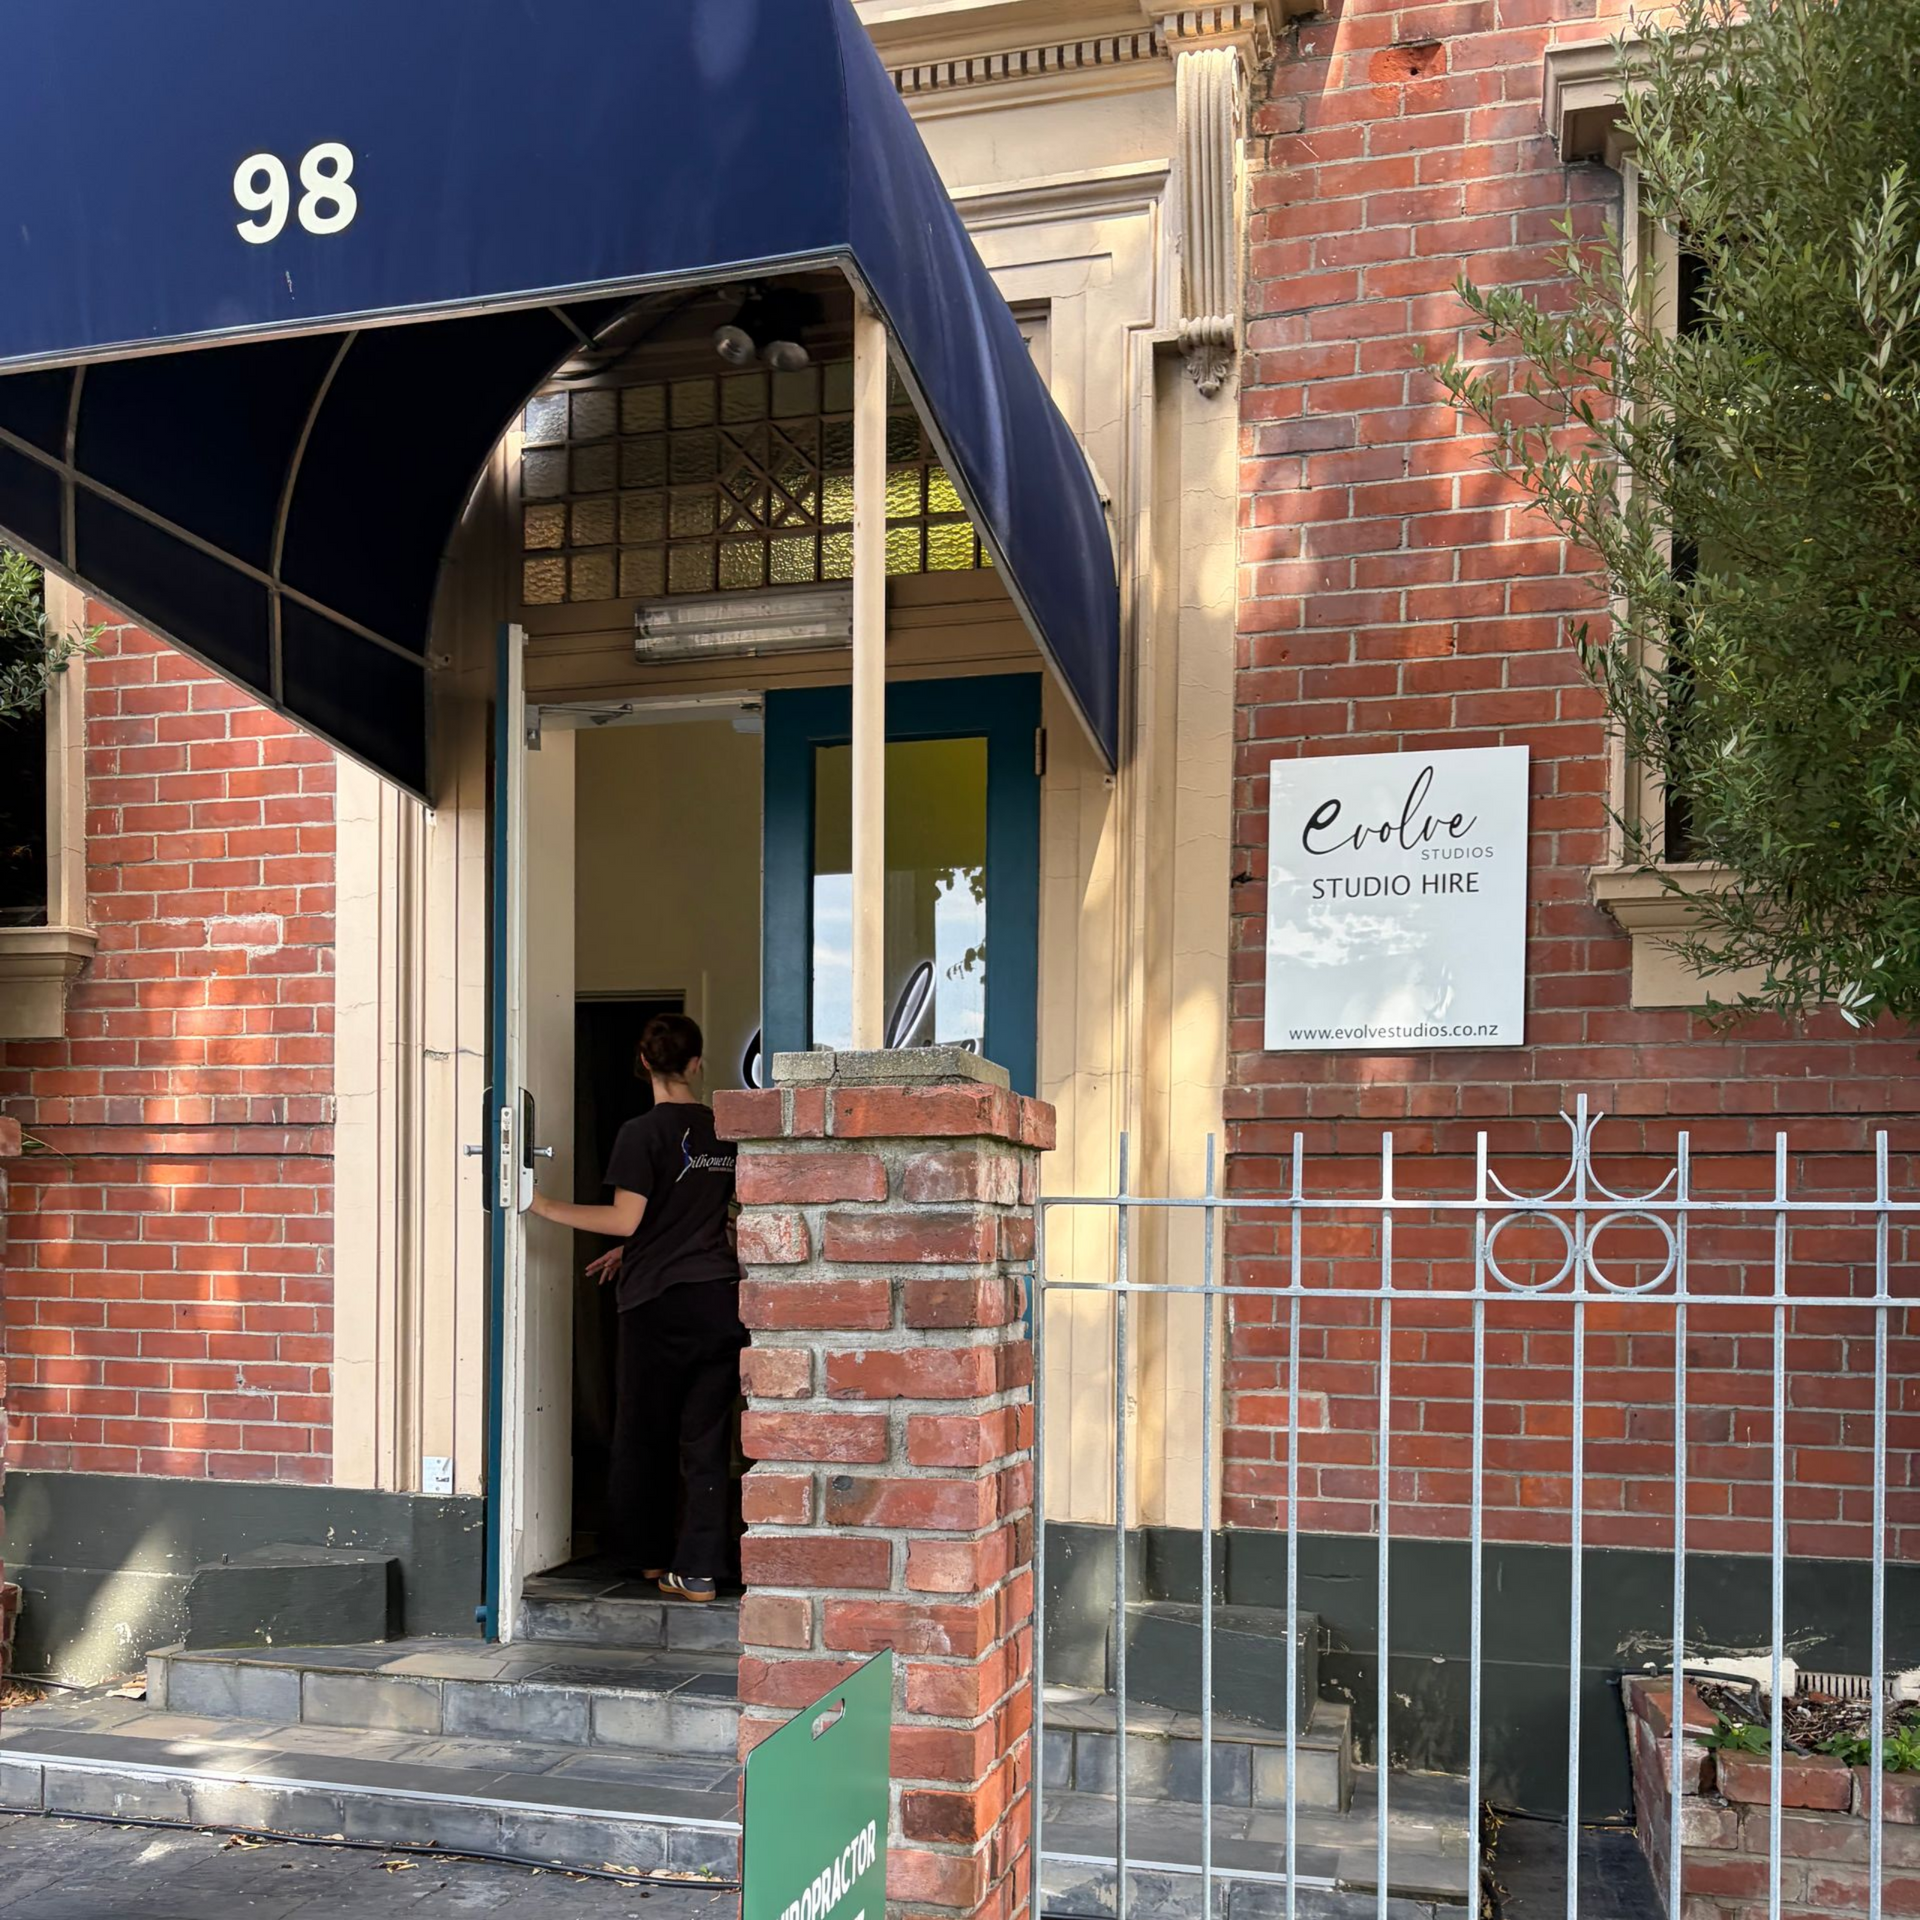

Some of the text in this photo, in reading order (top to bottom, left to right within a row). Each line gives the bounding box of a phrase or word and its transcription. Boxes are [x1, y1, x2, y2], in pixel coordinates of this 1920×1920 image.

[233, 142, 358, 244] 98
[1421, 846, 1494, 861] STUDIOS
[1312, 872, 1480, 900] STUDIO HIRE
[1289, 1023, 1499, 1041] www.evolvestudios.co.nz
